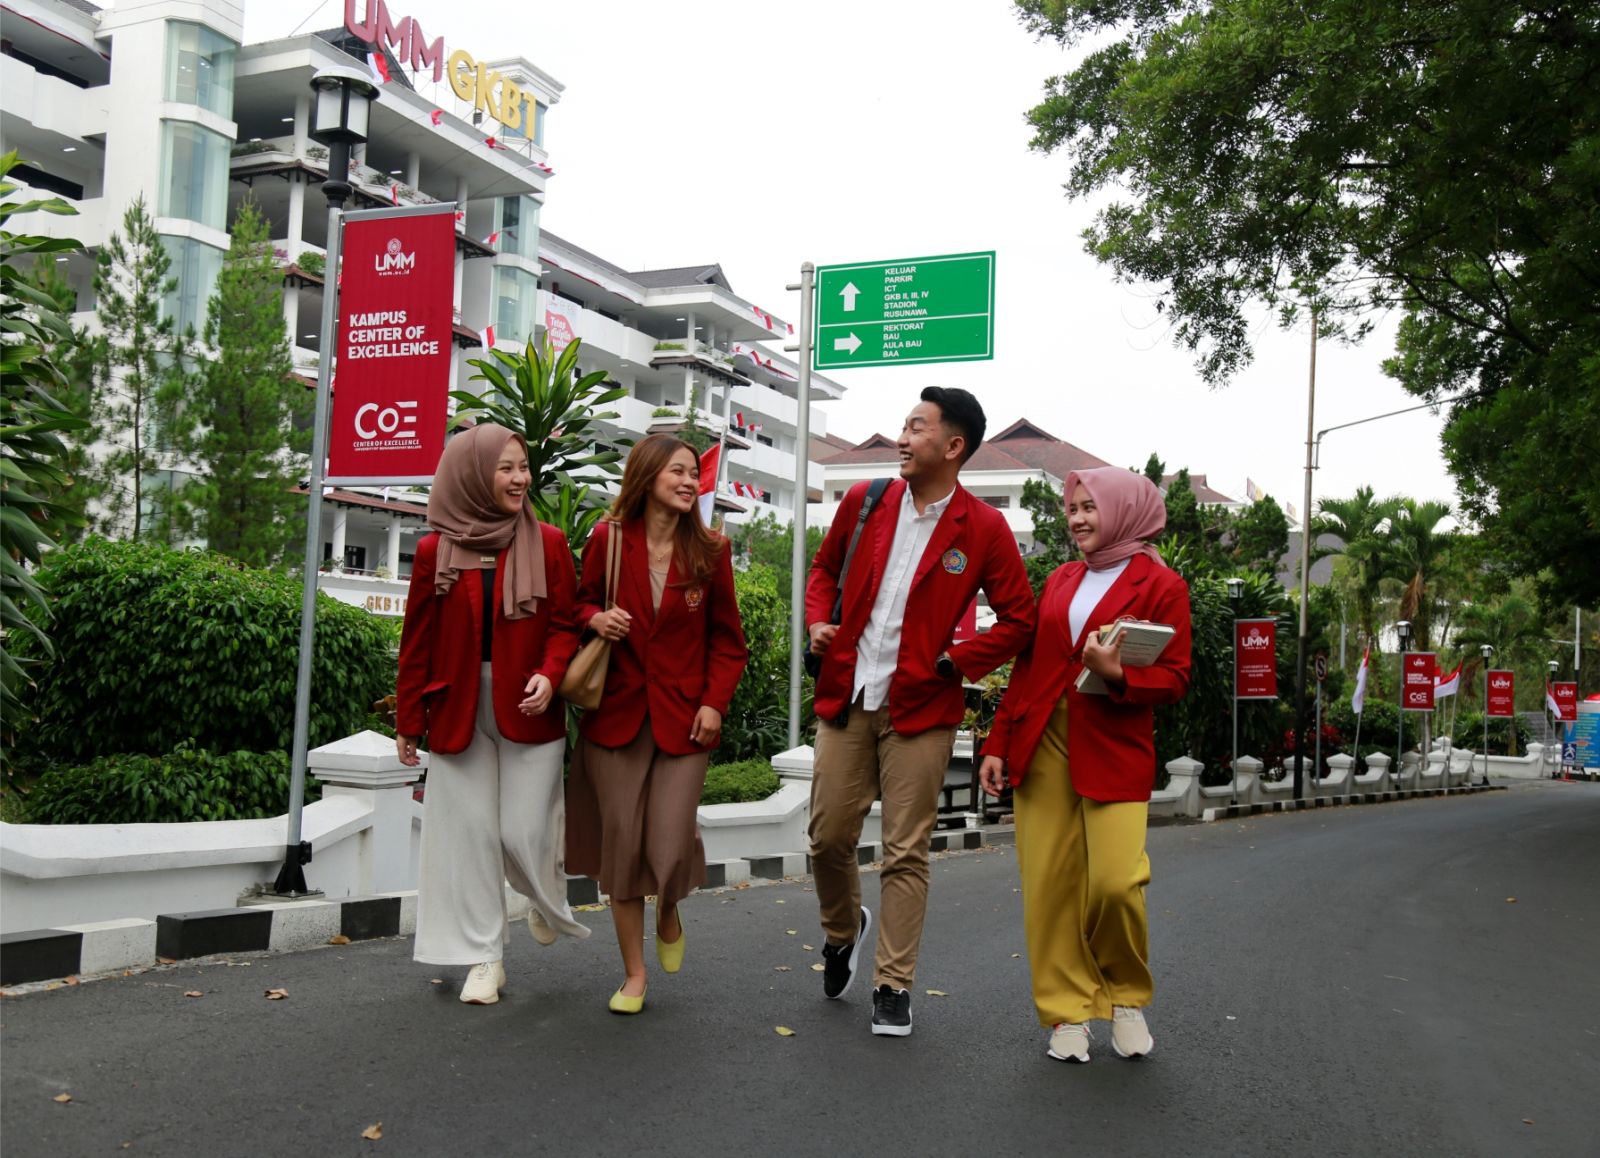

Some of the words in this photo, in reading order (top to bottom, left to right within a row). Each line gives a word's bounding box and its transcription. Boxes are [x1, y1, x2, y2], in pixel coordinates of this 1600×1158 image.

[344, 0, 444, 83] UMM
[375, 252, 415, 271] UMM
[885, 266, 916, 275] KELUAR
[884, 275, 913, 284] PARKIR
[884, 285, 897, 293] ICT
[884, 293, 901, 301] GKB
[921, 290, 929, 298] IV
[884, 301, 917, 309] STADION
[883, 308, 928, 318] RUSUNAWA
[349, 310, 407, 327] KAMPUS
[883, 322, 925, 332] REKTORAT
[348, 327, 402, 343] CENTER
[405, 325, 425, 339] OF
[883, 333, 900, 341] BAU
[883, 341, 904, 349] AULA
[905, 339, 922, 348] BAU
[348, 341, 439, 359] EXCELLENCE
[883, 350, 899, 358] BAA
[353, 440, 374, 448] CENTER
[384, 439, 420, 447] EXCELLENCE
[367, 595, 391, 611] GKB
[1242, 636, 1269, 647] UMM
